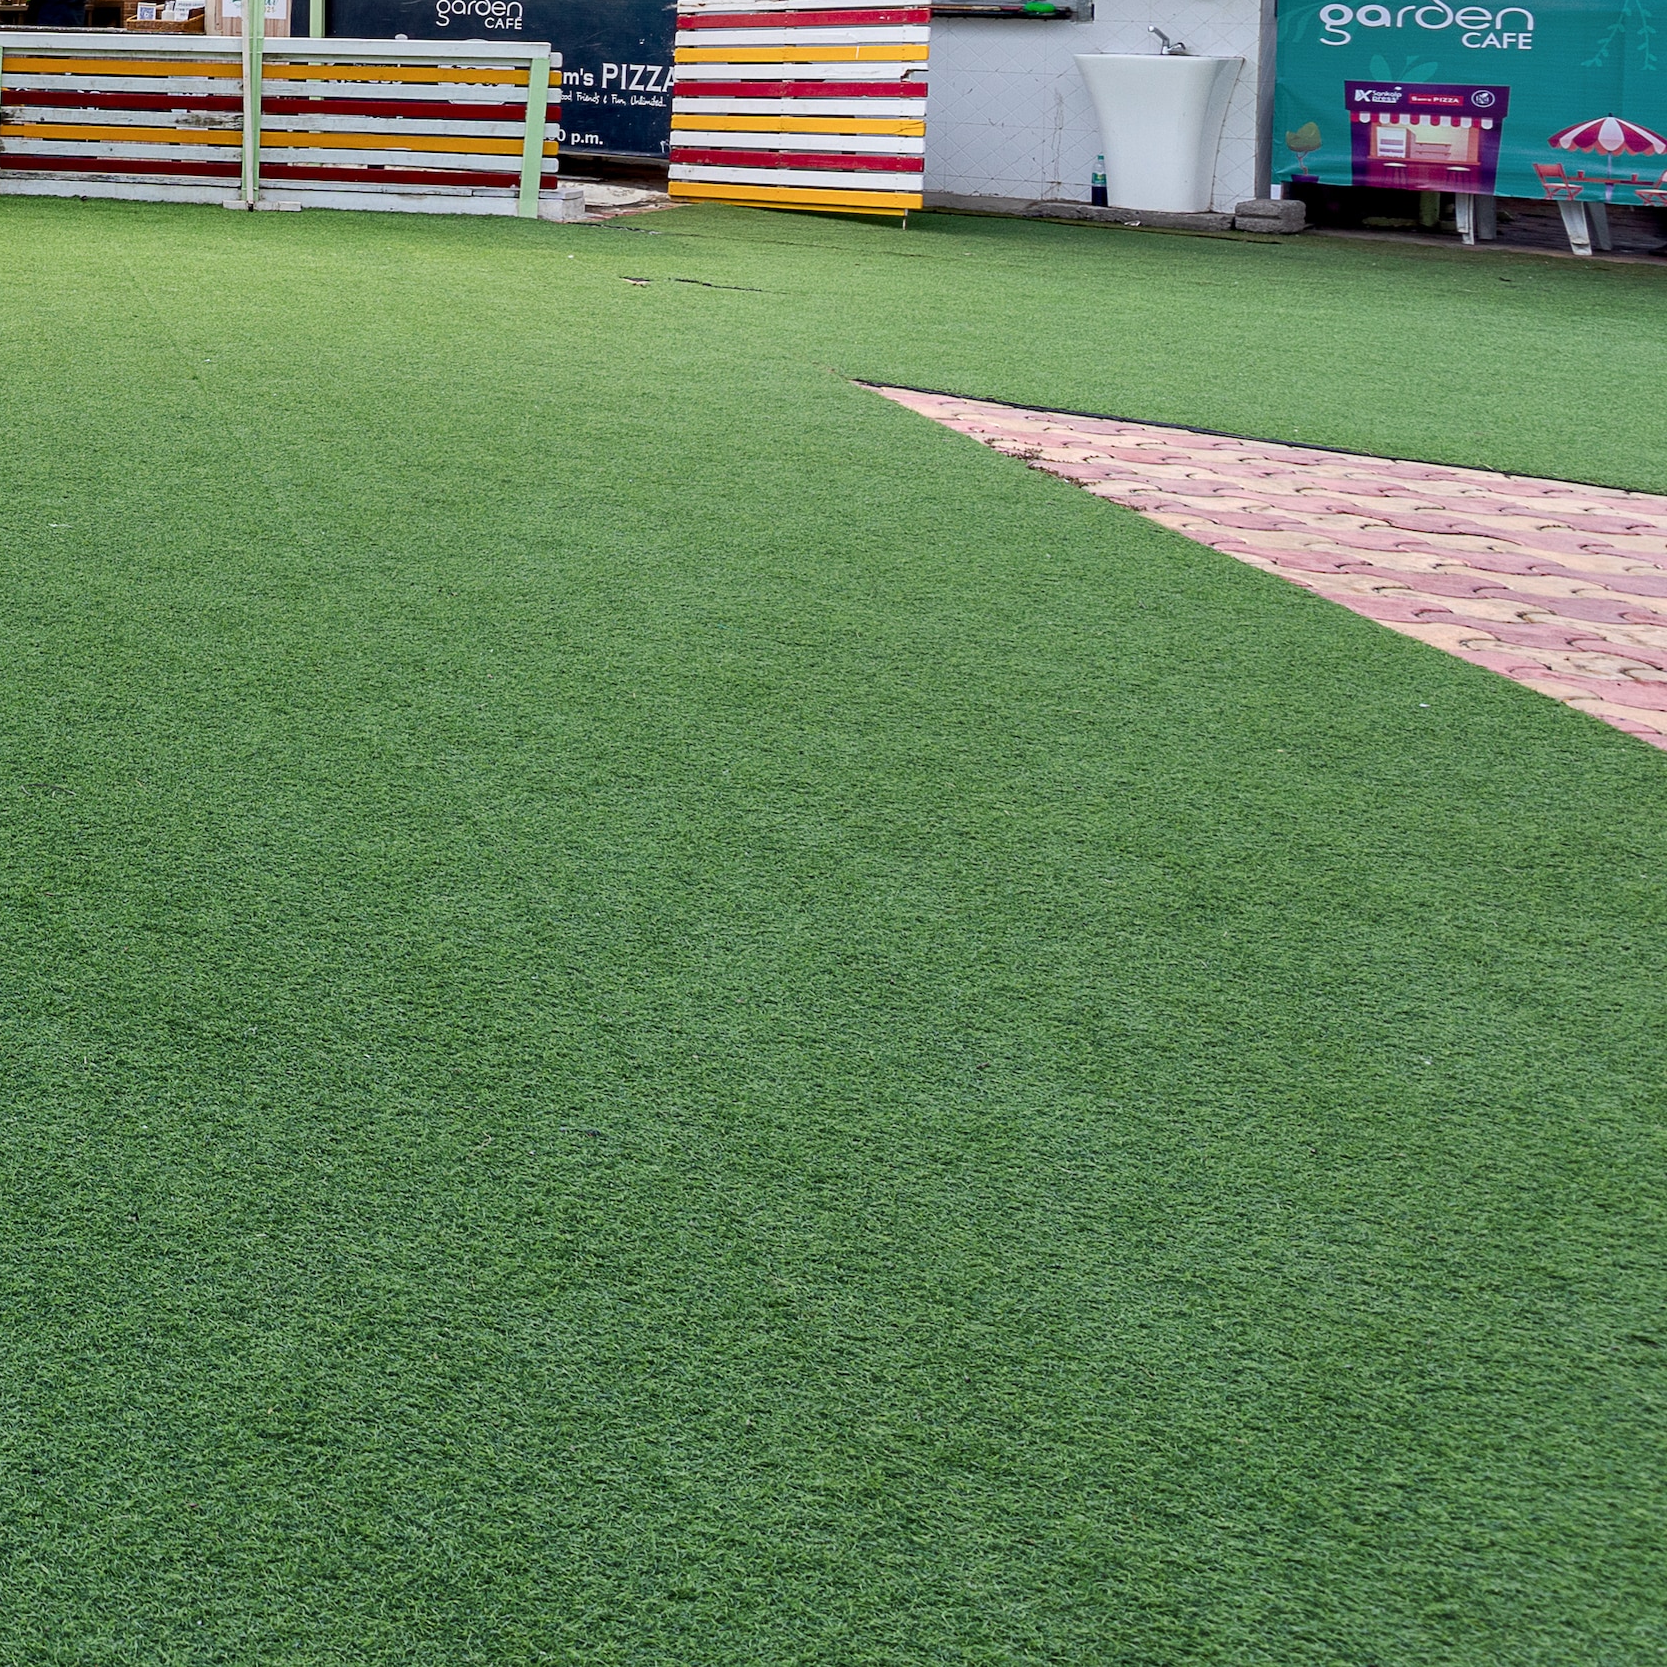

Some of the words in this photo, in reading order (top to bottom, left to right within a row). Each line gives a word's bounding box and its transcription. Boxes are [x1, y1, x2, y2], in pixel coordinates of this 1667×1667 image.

[1461, 31, 1533, 50] CAFE
[560, 91, 572, 102] ood
[571, 132, 604, 146] p.m.
